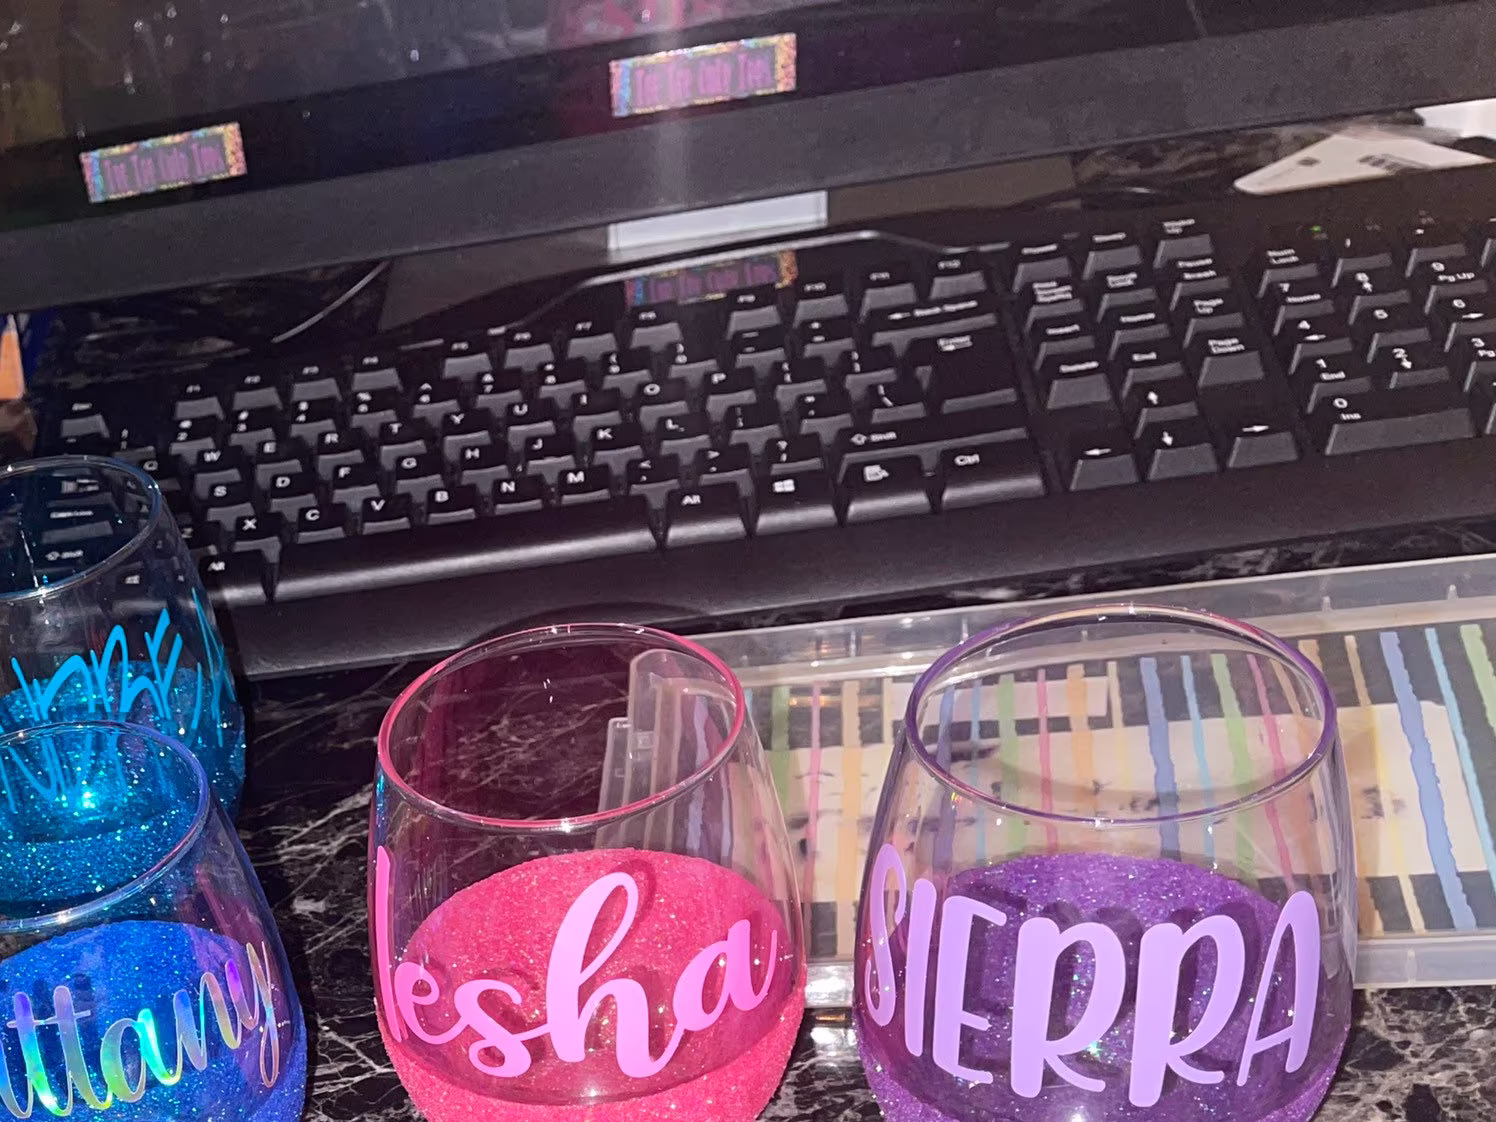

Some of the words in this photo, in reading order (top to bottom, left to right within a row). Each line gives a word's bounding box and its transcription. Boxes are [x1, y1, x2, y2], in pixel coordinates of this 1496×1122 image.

[711, 372, 726, 384] P
[513, 403, 528, 416] U
[1333, 398, 1348, 409] 0
[451, 413, 464, 424] Y
[390, 423, 402, 434] T
[597, 428, 613, 440] K
[324, 433, 339, 444] R
[532, 438, 543, 450] J
[204, 451, 221, 462] W
[465, 448, 480, 459] H
[338, 466, 351, 478] F
[567, 471, 585, 484] M
[275, 476, 290, 488] D
[500, 481, 516, 493] N
[214, 485, 227, 497] S
[371, 499, 385, 511] V
[305, 509, 320, 521] C
[242, 518, 257, 531] X
[864, 843, 1322, 1108] SIERRA
